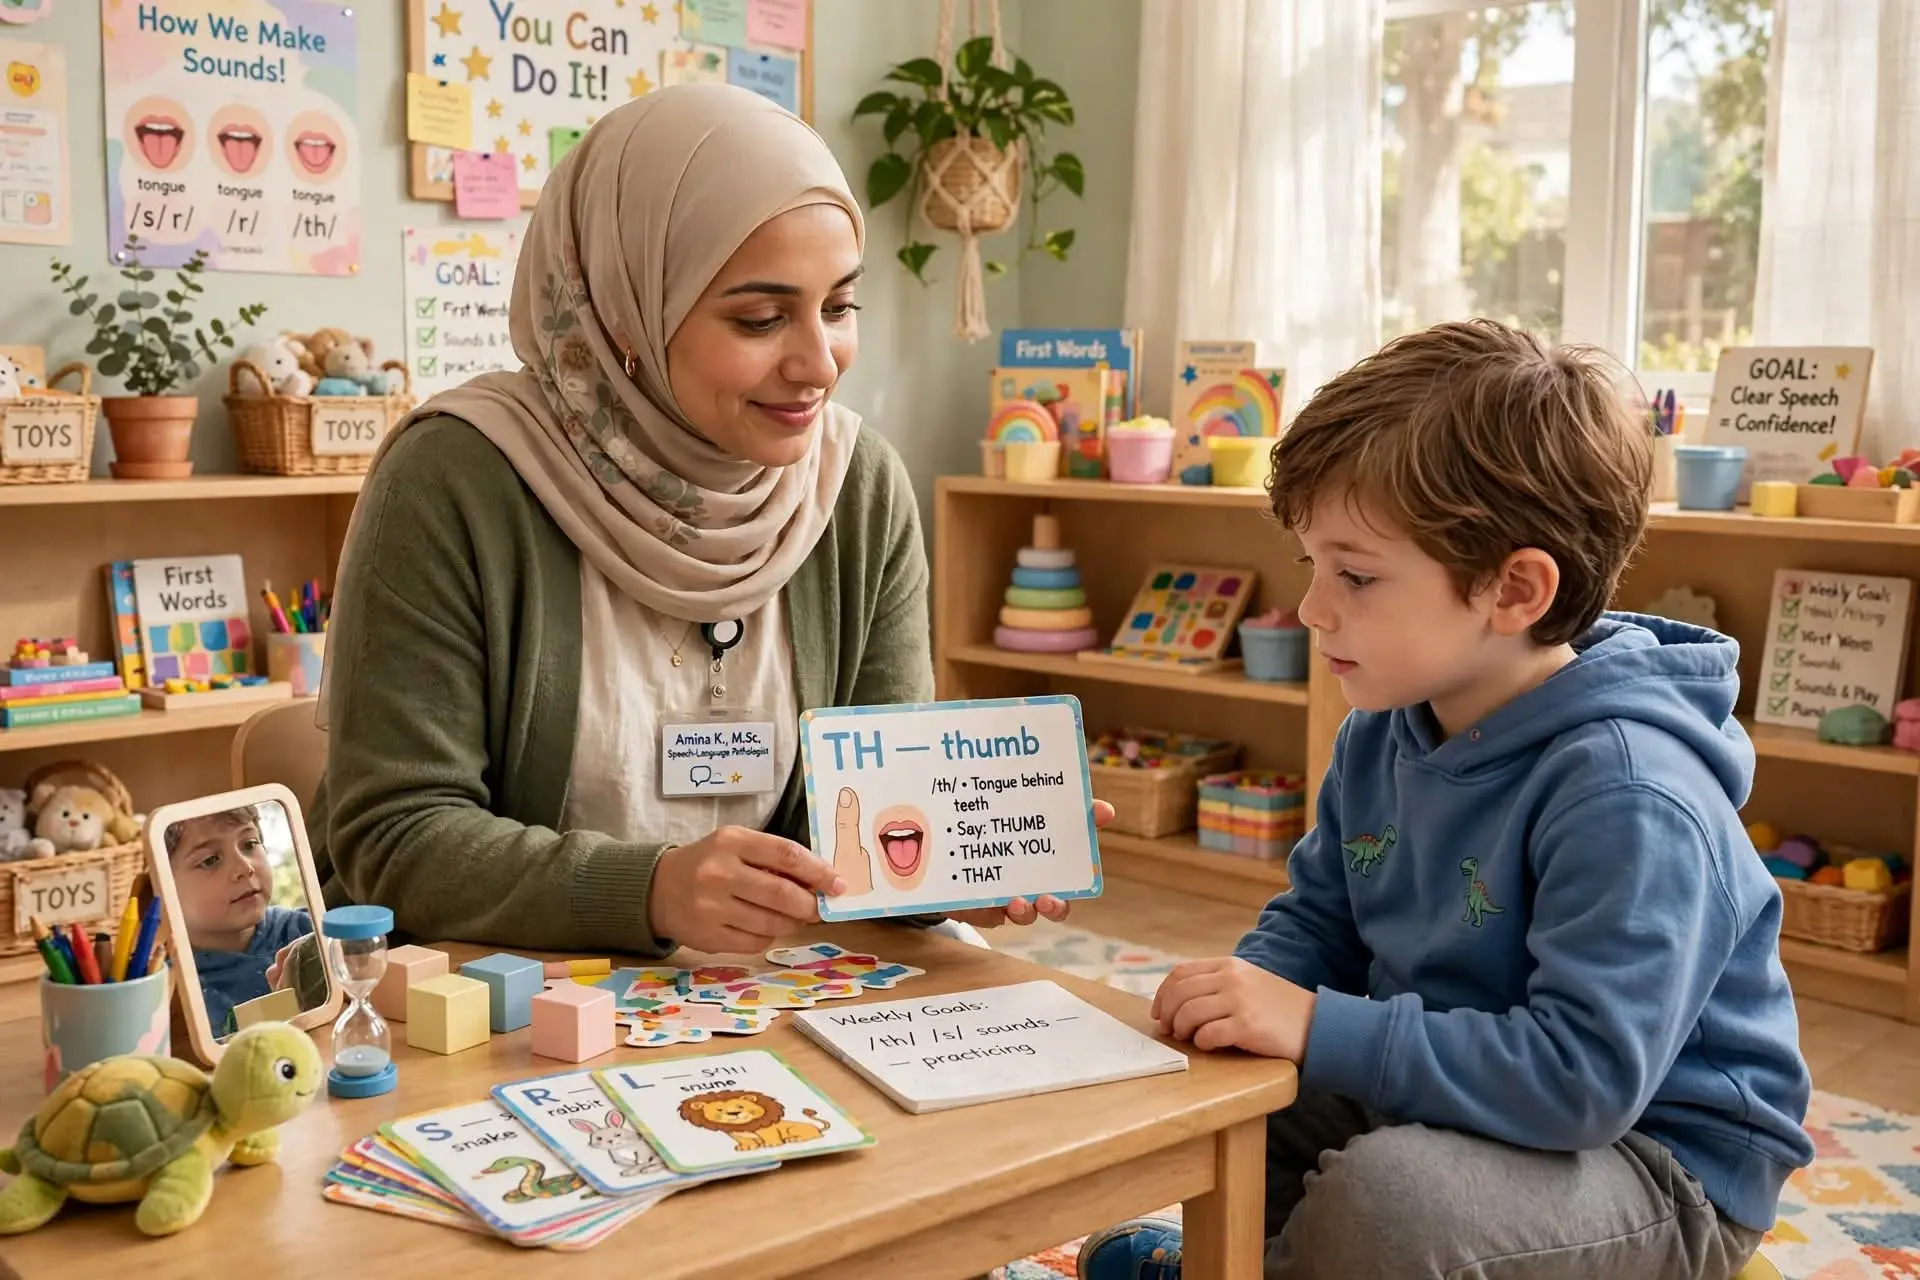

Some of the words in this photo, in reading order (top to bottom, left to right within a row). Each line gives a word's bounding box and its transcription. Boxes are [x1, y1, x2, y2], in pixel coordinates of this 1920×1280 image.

[138, 4, 198, 36] How
[207, 12, 249, 43] We
[257, 20, 326, 53] Make
[489, 0, 552, 46] You
[566, 11, 628, 55] Can
[183, 48, 286, 84] Sounds!
[512, 53, 557, 95] Do
[568, 61, 607, 102] It!
[137, 178, 186, 196] tongue
[217, 184, 263, 201] tongue
[292, 189, 335, 205] tongue
[226, 208, 259, 235] /r/
[292, 213, 337, 240] /th/
[435, 261, 501, 287] GOAL:
[474, 301, 509, 317] Word
[1016, 339, 1053, 359] First
[1055, 338, 1107, 360] Words
[1750, 358, 1818, 380] GOAL:
[1730, 386, 1774, 406] Clear
[1778, 387, 1839, 412] Speech
[324, 419, 376, 441] TOYS
[1735, 414, 1837, 435] Confidence!
[12, 424, 72, 449] TOYS
[164, 565, 214, 587] First
[159, 590, 228, 613] Words
[675, 733, 711, 746] Amina
[714, 732, 729, 746] K.,
[731, 731, 761, 744] M.Sc.
[822, 729, 884, 771] TH
[941, 725, 1040, 761] thumb
[931, 776, 958, 795] /th/
[970, 776, 1018, 794] Tongue
[1021, 771, 1065, 788] behind
[953, 795, 990, 812] teeth
[957, 821, 988, 840] Say:
[990, 814, 1047, 834] THUMB
[960, 841, 1015, 860] THANK
[1018, 837, 1056, 856] YOU,
[961, 865, 1003, 884] THAT
[31, 881, 97, 912] TOYS
[829, 1010, 913, 1027] Weekly
[921, 1001, 990, 1017] Goals:
[976, 1016, 1050, 1037] sounds
[921, 1042, 1037, 1070] practicing
[619, 1072, 655, 1090] L
[521, 1088, 560, 1106] R
[547, 1098, 605, 1118] rabbit
[415, 1122, 453, 1142] S
[451, 1131, 520, 1153] snake
